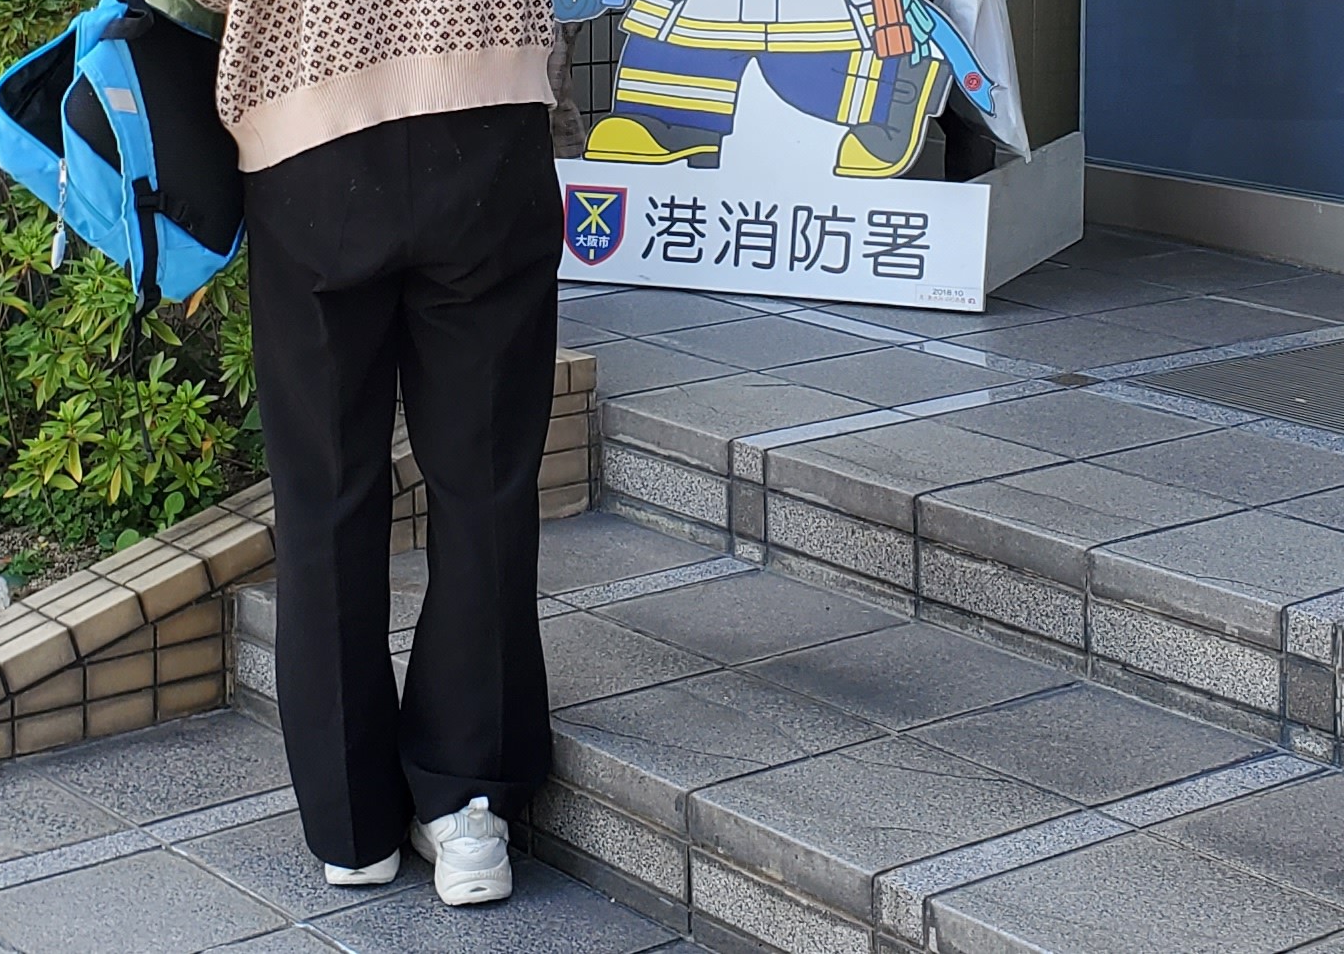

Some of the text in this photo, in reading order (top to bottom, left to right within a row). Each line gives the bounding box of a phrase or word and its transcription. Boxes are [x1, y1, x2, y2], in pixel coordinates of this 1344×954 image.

[575, 234, 611, 249] 大阪市
[641, 194, 931, 280] 港消防署
